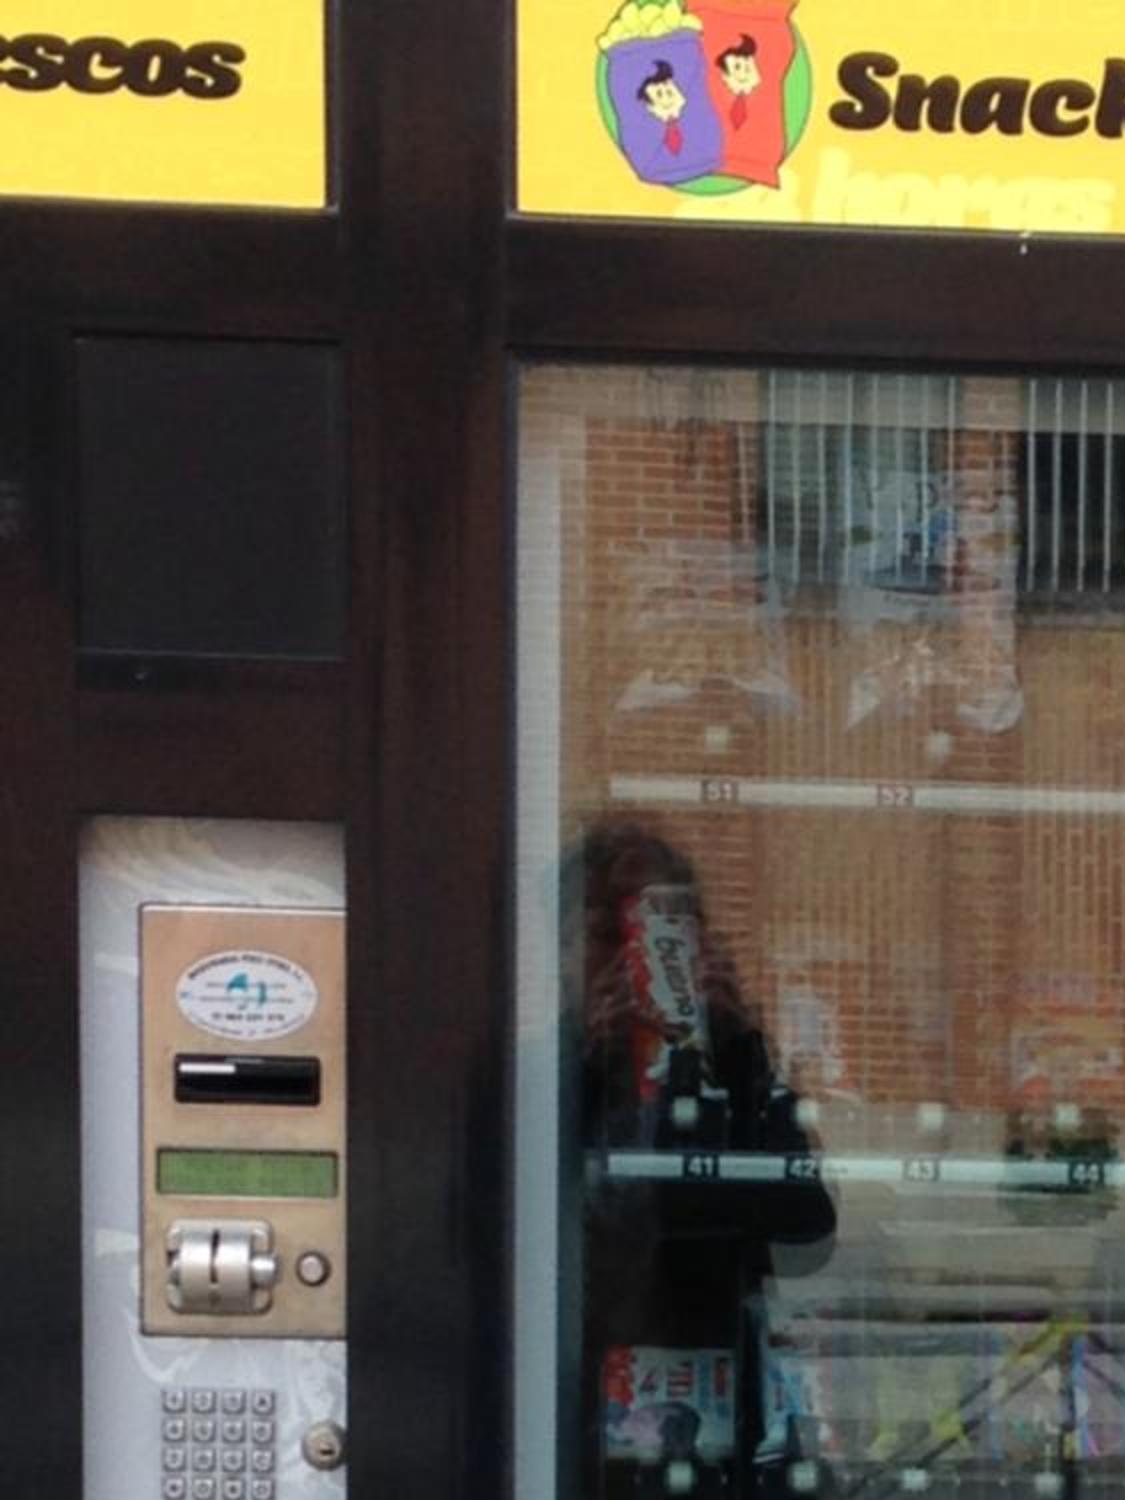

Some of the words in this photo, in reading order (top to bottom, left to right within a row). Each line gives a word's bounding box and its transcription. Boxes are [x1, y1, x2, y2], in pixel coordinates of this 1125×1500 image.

[0, 32, 247, 100] scos
[687, 1156, 716, 1177] 41
[787, 1158, 815, 1178] 42
[1070, 1161, 1100, 1182] 44
